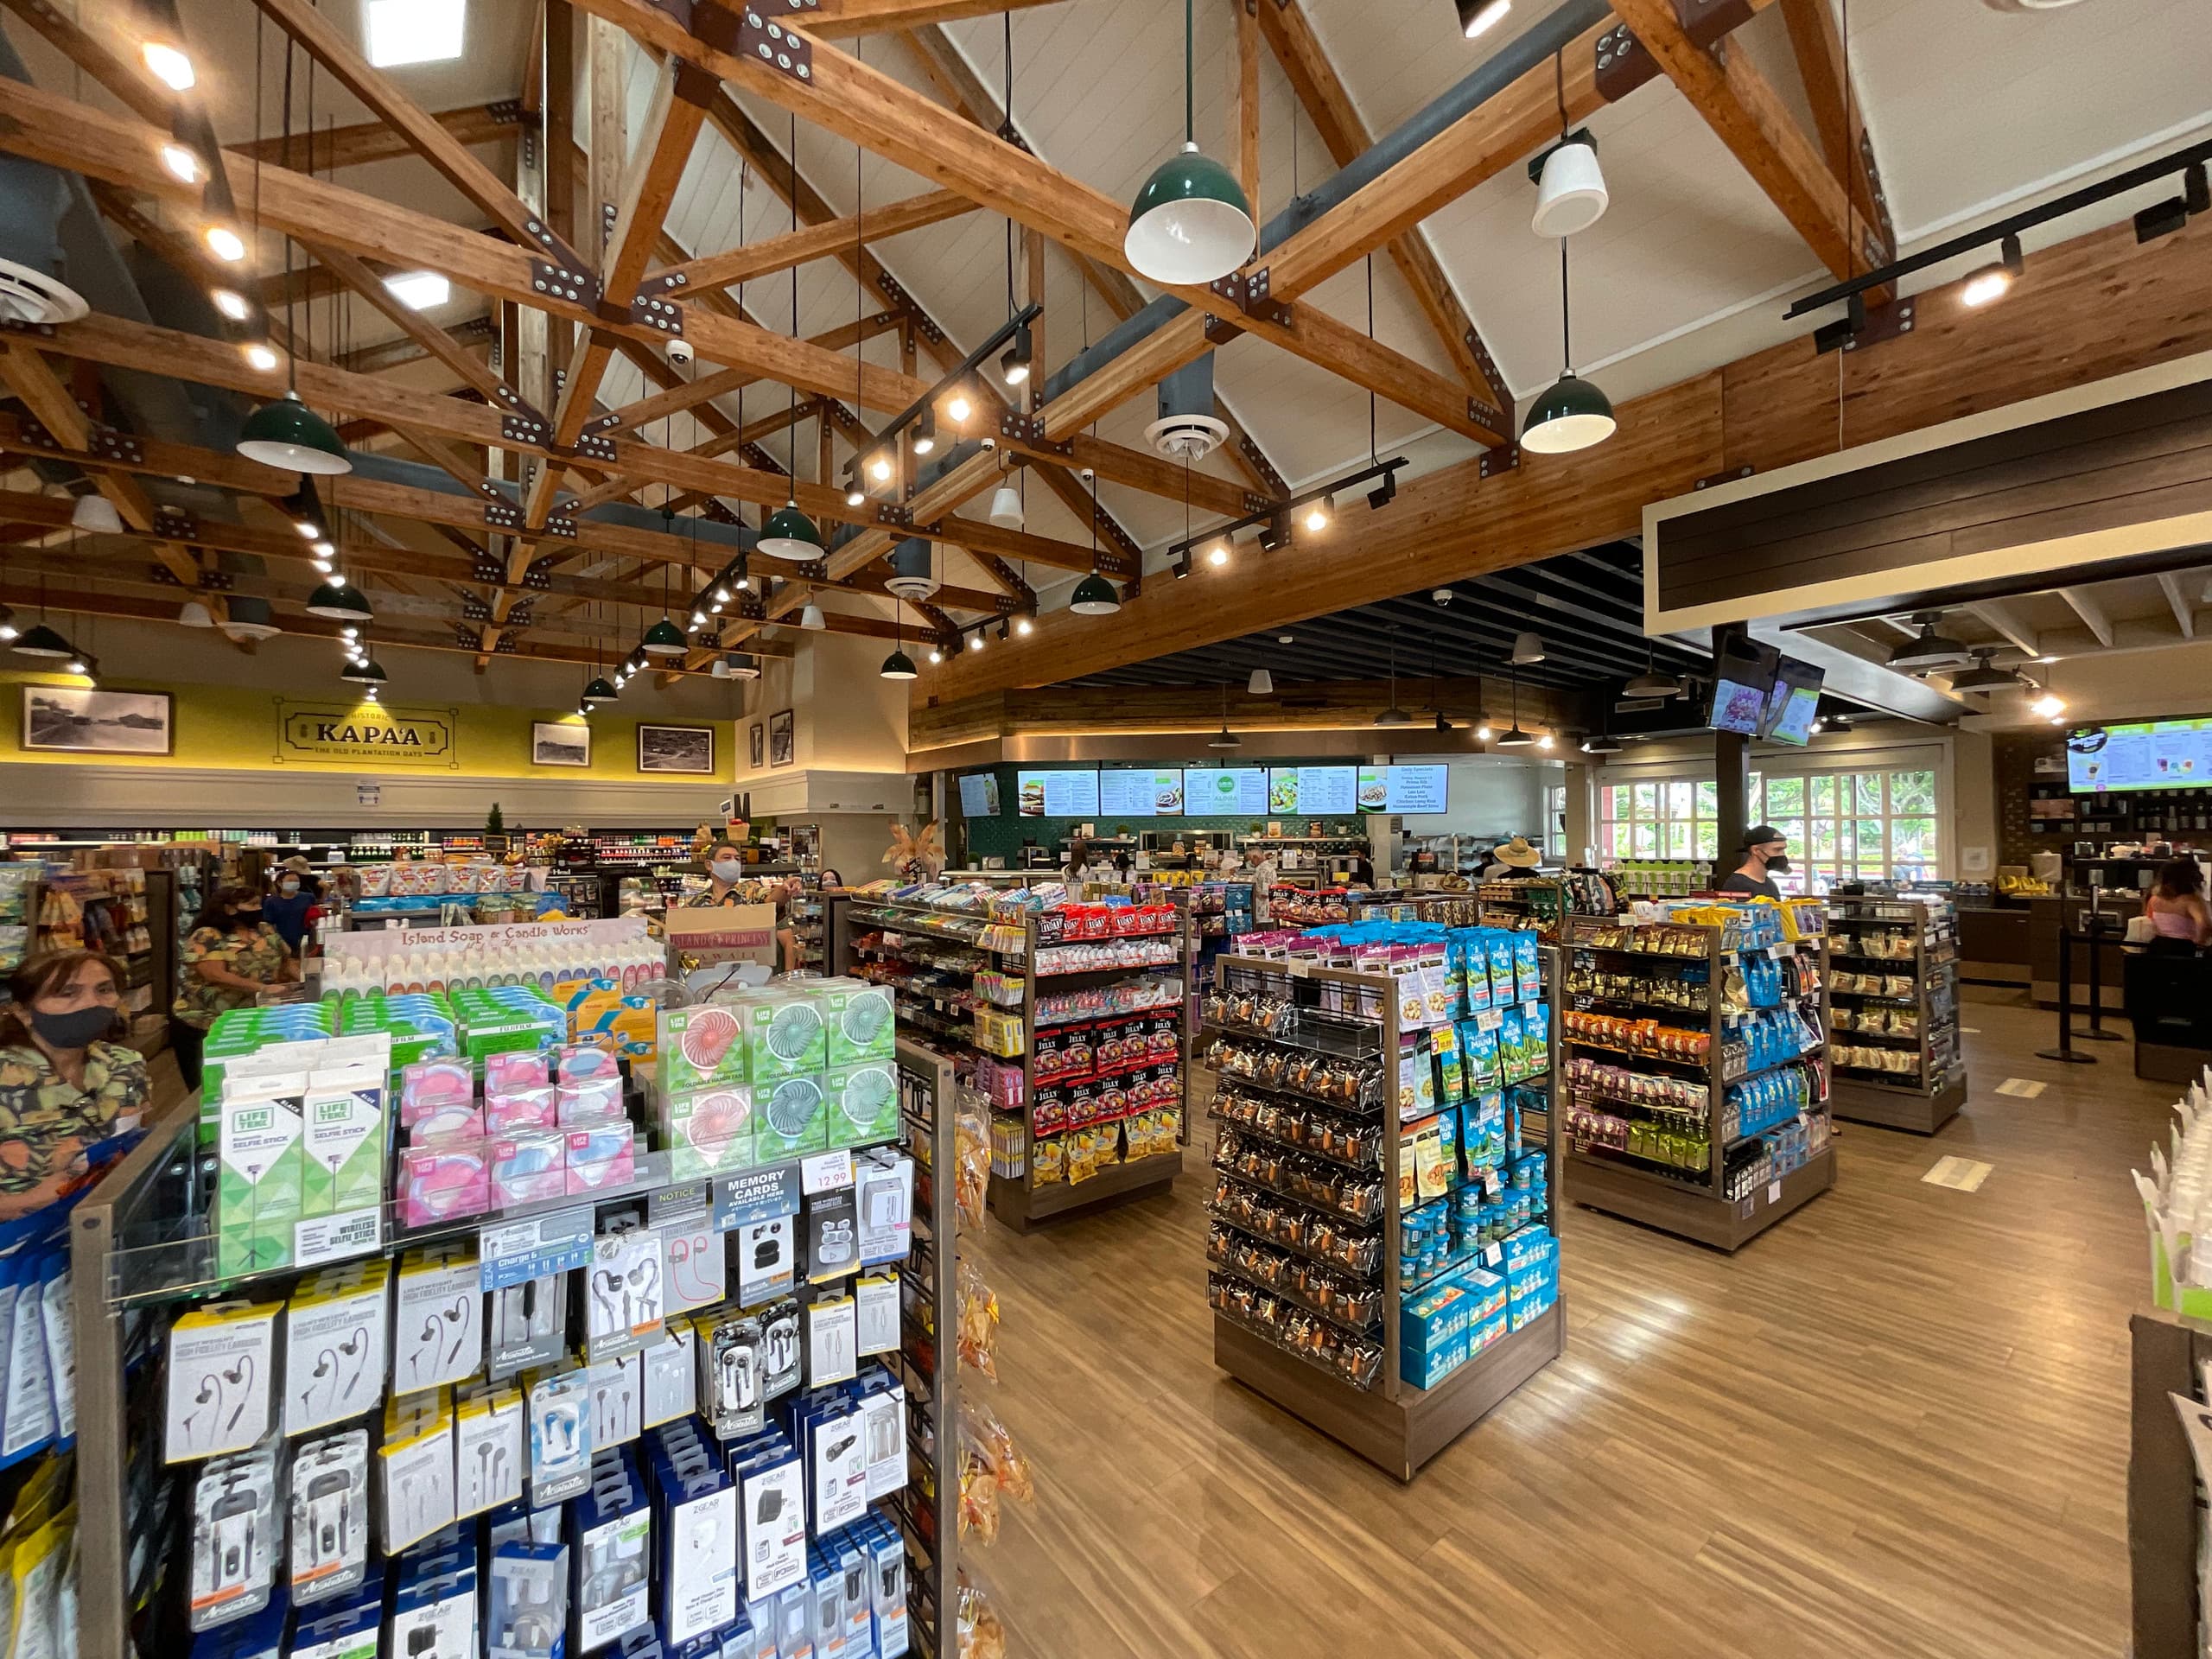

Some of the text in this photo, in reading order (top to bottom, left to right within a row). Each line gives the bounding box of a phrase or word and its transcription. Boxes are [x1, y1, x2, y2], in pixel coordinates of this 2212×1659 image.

[351, 712, 389, 721] HISTORIC
[402, 931, 446, 946] Island
[449, 930, 484, 944] Soap
[505, 926, 548, 939] Candle
[553, 924, 589, 936] Works
[672, 931, 769, 947] ISLAND PRINCESS
[699, 951, 756, 961] AWAII
[499, 1023, 532, 1033] FUJIFILM
[1125, 1025, 1140, 1034] JELLY
[1154, 1020, 1172, 1029] JELLY
[1069, 1034, 1087, 1044] JELLY
[1103, 1030, 1117, 1039] JELLY
[1038, 1040, 1056, 1051] JELLY
[1158, 1066, 1173, 1075] JELLY
[1132, 1072, 1147, 1082] JELLY
[1103, 1080, 1119, 1089] JELLY
[361, 1093, 375, 1104] BLUE
[1039, 1090, 1058, 1101] JELLY
[1073, 1088, 1090, 1098] JELLY
[280, 1099, 301, 1114] BLACK
[320, 1103, 346, 1114] LIFE
[239, 1110, 268, 1122] LIFE
[314, 1131, 341, 1140] SELFIE
[342, 1127, 366, 1135] STICK
[232, 1139, 262, 1149] SELFIE
[263, 1135, 289, 1145] STICK
[728, 1170, 785, 1192] MEMORY
[818, 1173, 846, 1187] 12.99
[659, 1188, 696, 1202] NOTICE
[734, 1182, 779, 1199] CARDS
[728, 1189, 785, 1208] AVAILABLE HERE
[340, 1220, 376, 1234] WIRELESS
[330, 1234, 352, 1245] SELFIE
[353, 1229, 376, 1240] STICK
[499, 1254, 530, 1268] Charge
[693, 1498, 720, 1514] ZGEAR
[603, 1517, 631, 1535] ZGEAR
[418, 1605, 451, 1622] ZGEAR
